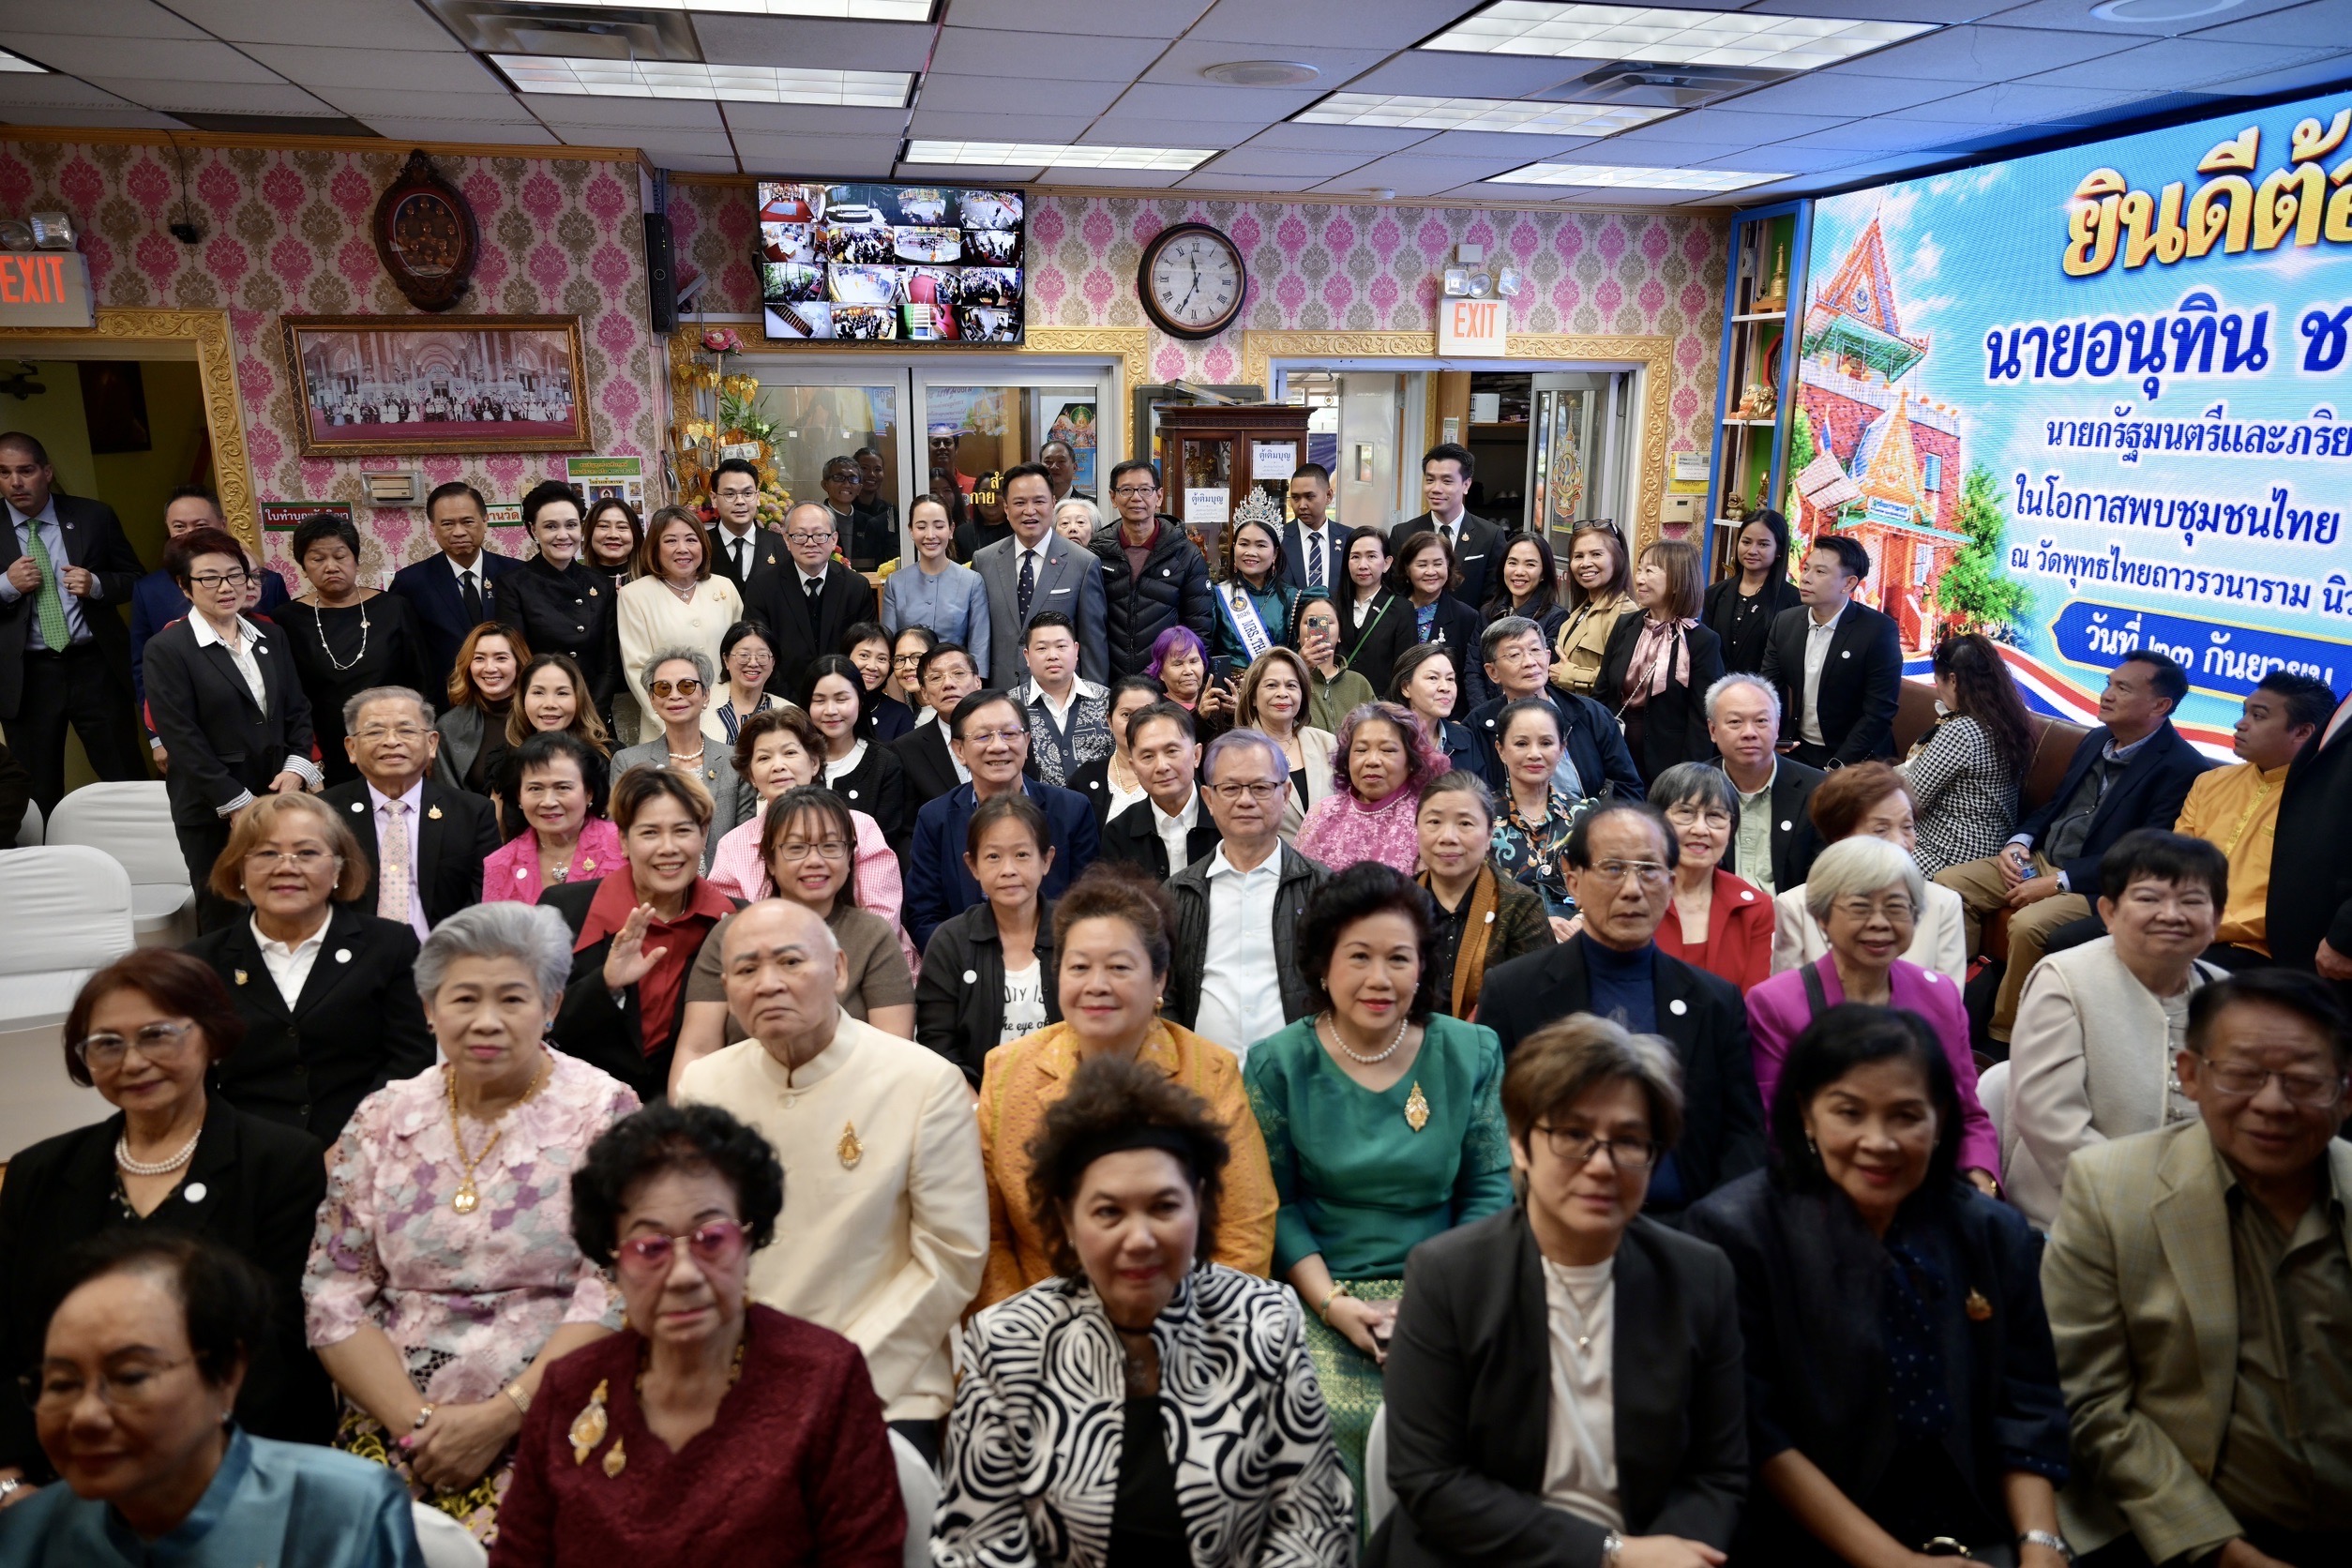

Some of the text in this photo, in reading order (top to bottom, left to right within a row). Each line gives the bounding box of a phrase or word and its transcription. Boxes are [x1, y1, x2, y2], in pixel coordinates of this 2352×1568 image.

[0, 256, 66, 303] EXIT
[1454, 303, 1497, 338] EXIT
[1986, 292, 2269, 400] นายอนุทิน
[2016, 474, 2341, 546] ในโอกาสพบชุมชนไทย
[2012, 547, 2028, 568] ณ
[2036, 540, 2311, 609] วัดพุทธไทยถาวรวนาราม
[1017, 1021, 1033, 1036] eye
